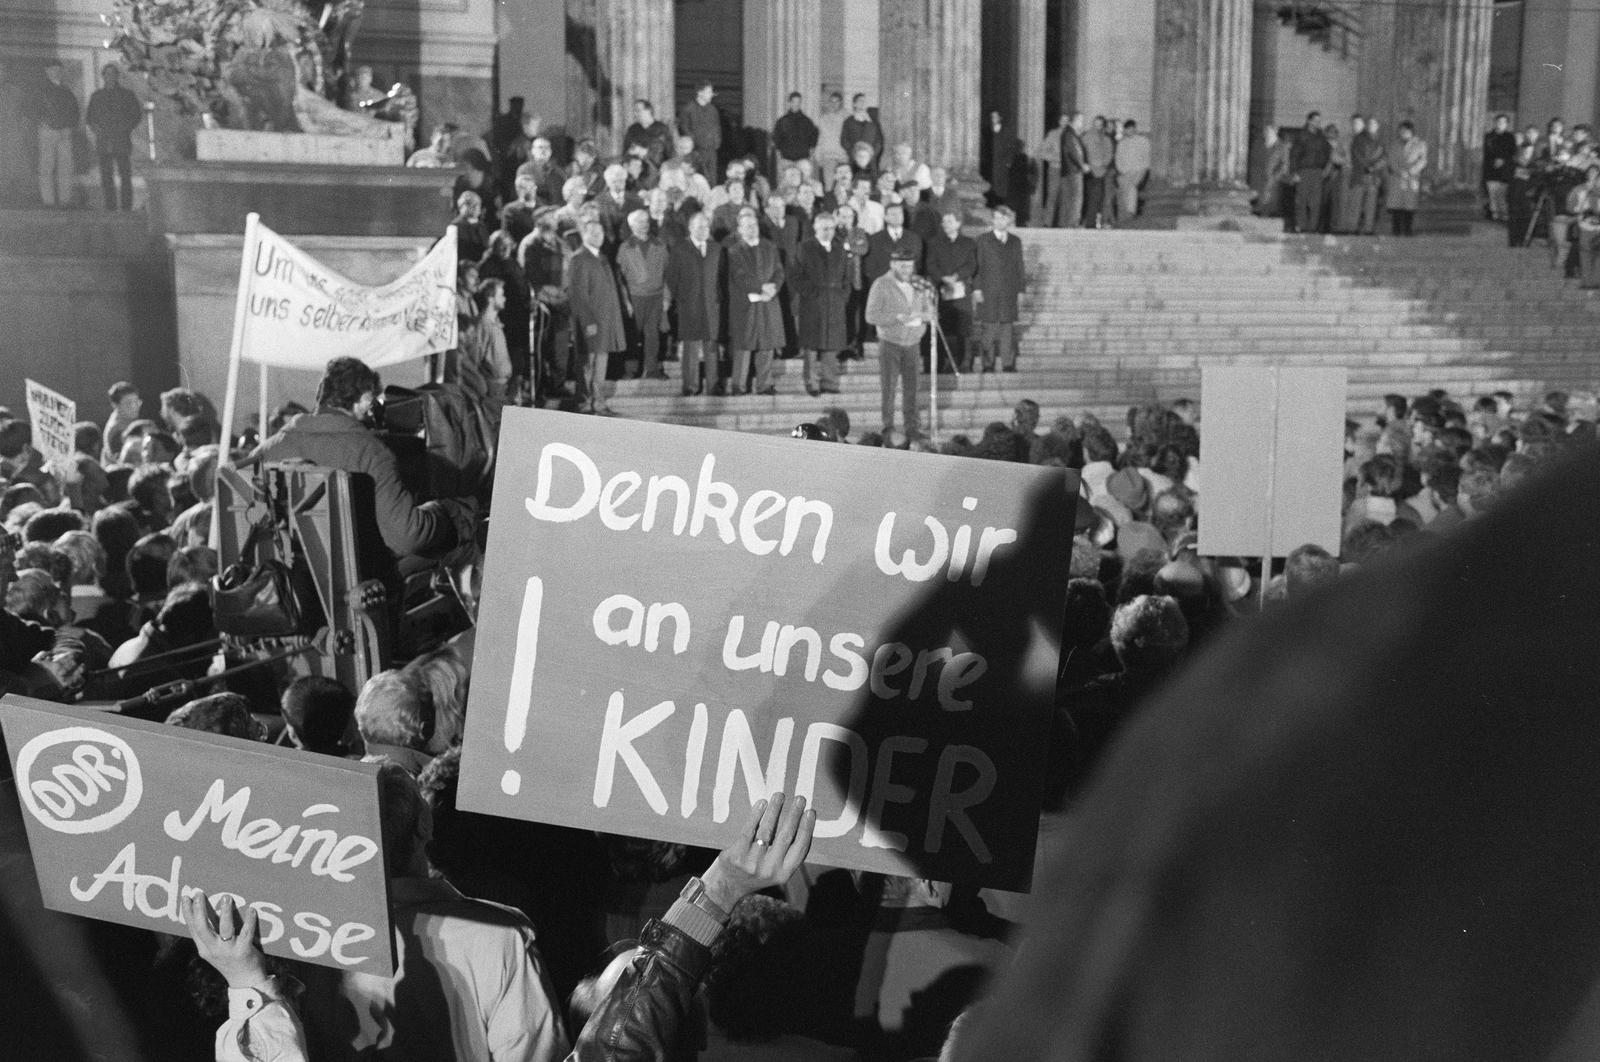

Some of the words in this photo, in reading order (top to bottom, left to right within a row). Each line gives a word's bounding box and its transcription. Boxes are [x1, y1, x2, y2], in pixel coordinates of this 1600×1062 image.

[250, 293, 291, 320] uns
[255, 240, 295, 284] Um
[525, 442, 833, 565] Denken
[875, 496, 1018, 587] wir
[593, 594, 692, 654] an
[722, 614, 988, 712] unsere
[164, 778, 379, 882] Meine
[593, 691, 998, 865] KINDER
